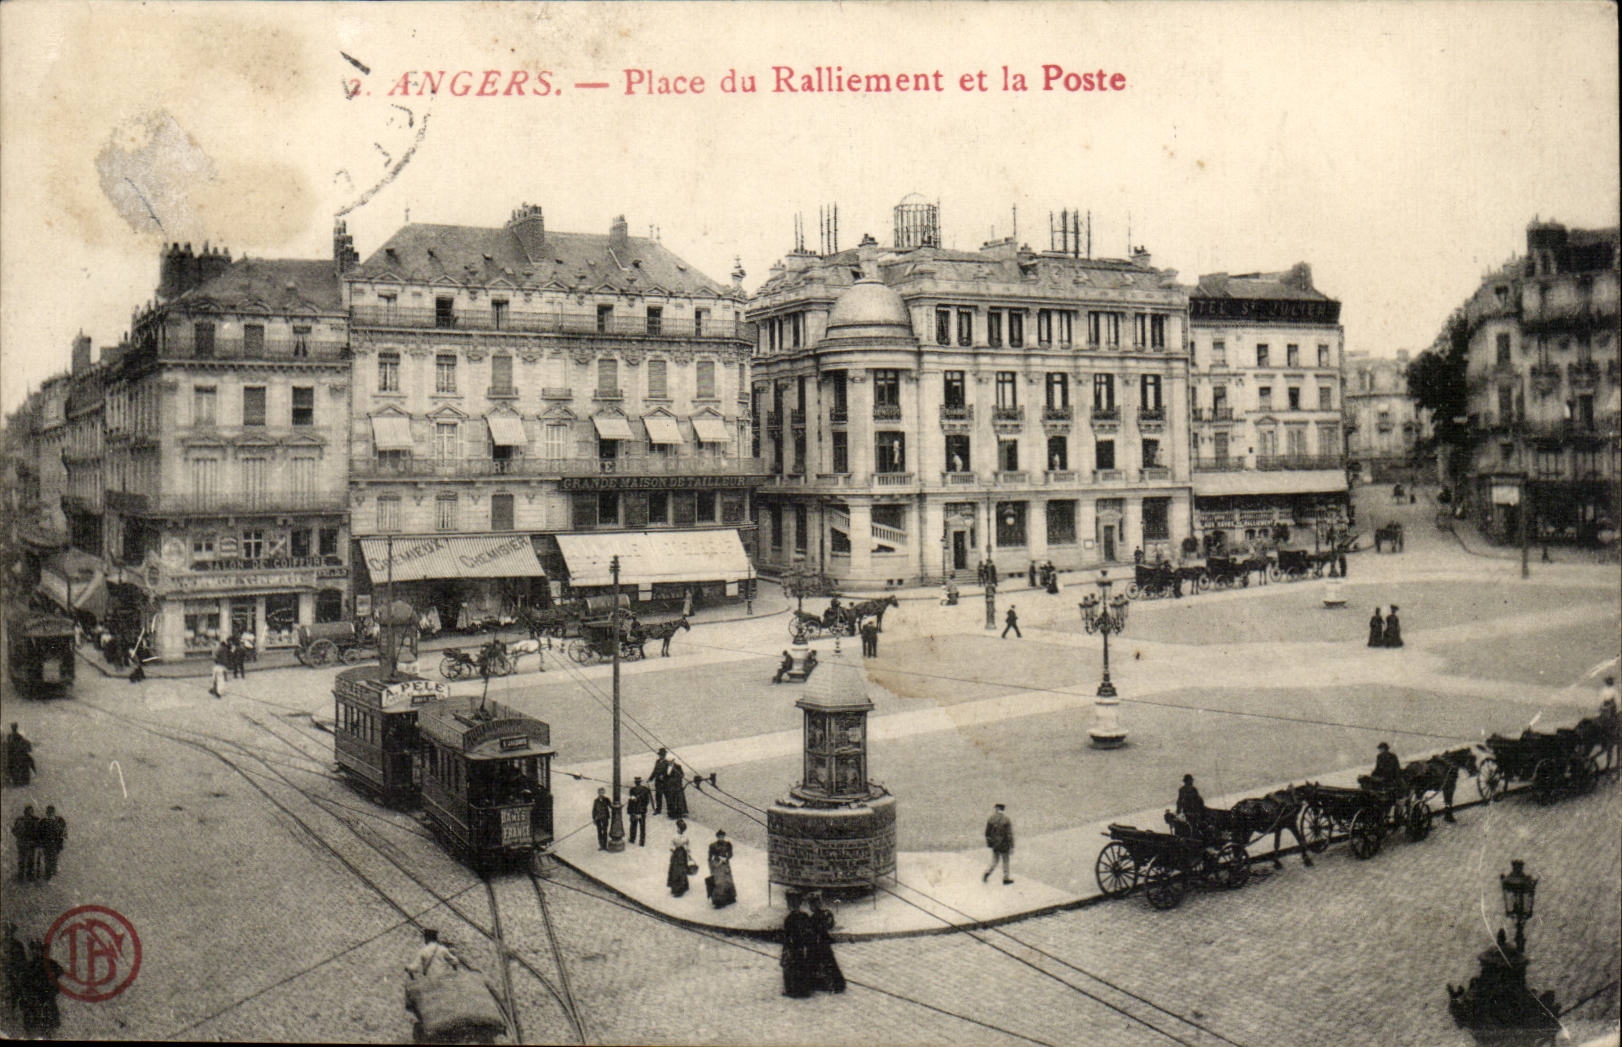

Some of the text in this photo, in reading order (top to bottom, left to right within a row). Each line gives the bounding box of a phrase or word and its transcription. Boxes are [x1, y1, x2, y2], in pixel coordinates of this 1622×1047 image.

[563, 478, 617, 489] GRANDE
[620, 477, 667, 488] MAISON
[670, 477, 685, 488] DE
[687, 475, 746, 487] TAILLEUR
[208, 557, 328, 571] SALON DE COIFFURE
